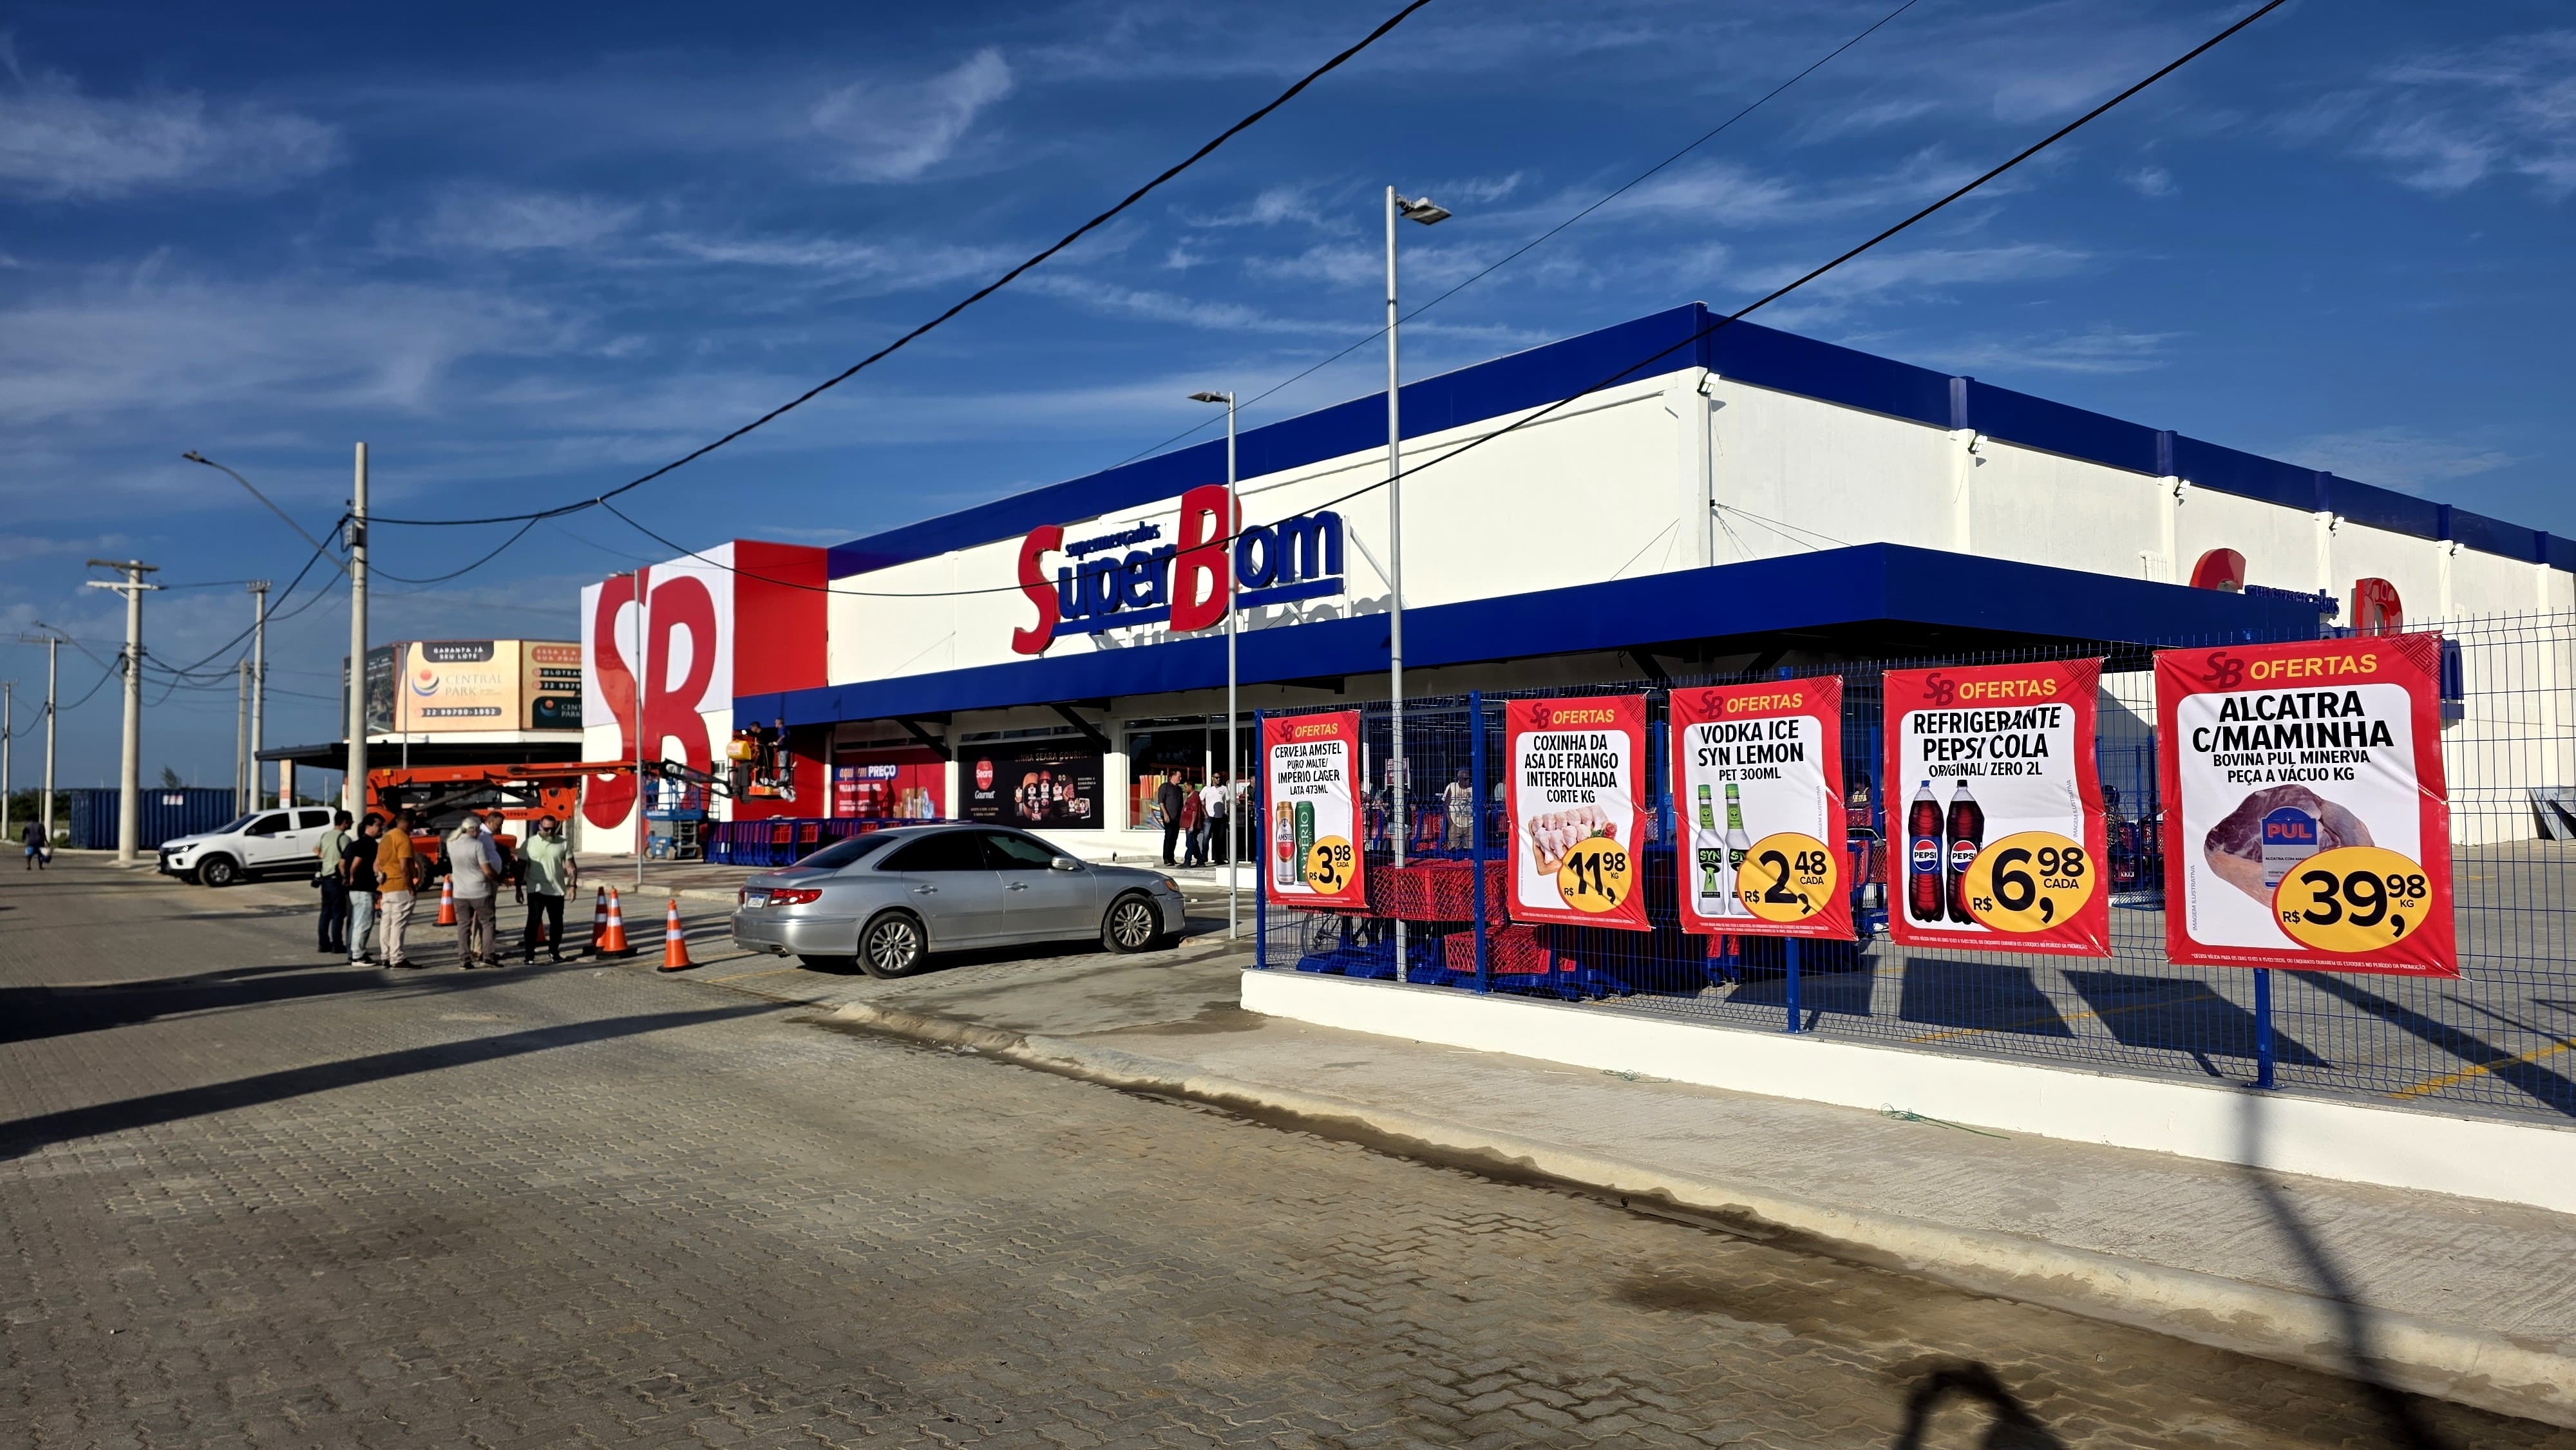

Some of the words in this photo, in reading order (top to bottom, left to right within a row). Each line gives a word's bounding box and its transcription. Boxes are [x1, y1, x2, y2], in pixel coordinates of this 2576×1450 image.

[1065, 522, 1161, 560] supermercados
[1011, 484, 1344, 655] SuperBom
[2202, 652, 2244, 688] SB
[2250, 654, 2377, 679] OFERTAS
[446, 674, 503, 684] CENTRAL
[445, 686, 477, 696] PARK
[1923, 672, 1955, 706] SB
[1960, 679, 2056, 699] OFERTAS
[582, 566, 717, 854] SB
[1698, 690, 1723, 719] SB
[1727, 693, 1803, 713] OFERTAS
[2219, 690, 2365, 722] ALCATRA
[1530, 702, 1551, 729] SB
[1553, 709, 1615, 724] OFERTAS
[1914, 706, 2061, 734] REFRIGERANTE
[1295, 722, 1338, 738] OFERTAS
[1700, 722, 1763, 744] VODKA
[1769, 719, 1799, 740] ICE
[2192, 720, 2394, 753] C/MAMINHA
[1275, 746, 1307, 758] CERVEJA
[1309, 742, 1341, 757] AMSTEL
[1534, 735, 1586, 750] COXINHA
[1591, 735, 1607, 750] DA
[1924, 737, 1986, 761] PEPSI
[1989, 733, 2049, 758] COLA
[1035, 751, 1057, 761] SEARA
[1525, 753, 1546, 768] ASA
[1549, 753, 1564, 768] DE
[1567, 753, 1618, 769] FRANGO
[1698, 747, 1730, 766] SYN
[1737, 742, 1803, 764] LEMON
[2213, 753, 2264, 767] BOVINA
[2268, 752, 2296, 765] PUL
[2300, 750, 2371, 764] MINERVA
[868, 765, 896, 780] PREÇO
[1287, 760, 1304, 769] PURO
[1929, 762, 1987, 777] ORIGINAL/
[1991, 762, 2023, 776] ZERO
[2027, 762, 2043, 775] 2L
[976, 769, 993, 778] Seara
[1313, 769, 1340, 782] LAGER
[1527, 771, 1617, 787] INTERFOLHADA
[1719, 769, 1737, 781] PET
[1740, 767, 1781, 780] 300ML
[2228, 770, 2262, 786] PEÇA
[2266, 770, 2275, 782] A
[2278, 765, 2329, 782] VÁCUO
[2333, 767, 2354, 780] KG
[975, 791, 996, 799] Gourmet
[1290, 786, 1305, 795] LATA
[1306, 784, 1328, 794] 473ML
[1547, 789, 1578, 802] CORTE
[1581, 790, 1595, 803] KG
[2067, 780, 2077, 814] ILUSTRATIVA
[2268, 824, 2312, 838] PUL
[1309, 872, 1317, 880] R$
[1334, 845, 1350, 861] 98
[1700, 851, 1720, 861] SYN
[1564, 887, 1574, 896] R$
[1603, 852, 1625, 872] 98
[1745, 890, 1759, 904] R$
[1795, 851, 1826, 876] 48
[1800, 876, 1824, 885] CADA
[1973, 896, 1993, 912] R$
[2037, 847, 2085, 877] 98
[2043, 879, 2079, 889] CADA
[2282, 910, 2300, 924] R$
[2386, 874, 2426, 899] 98
[2400, 899, 2414, 908] KG
